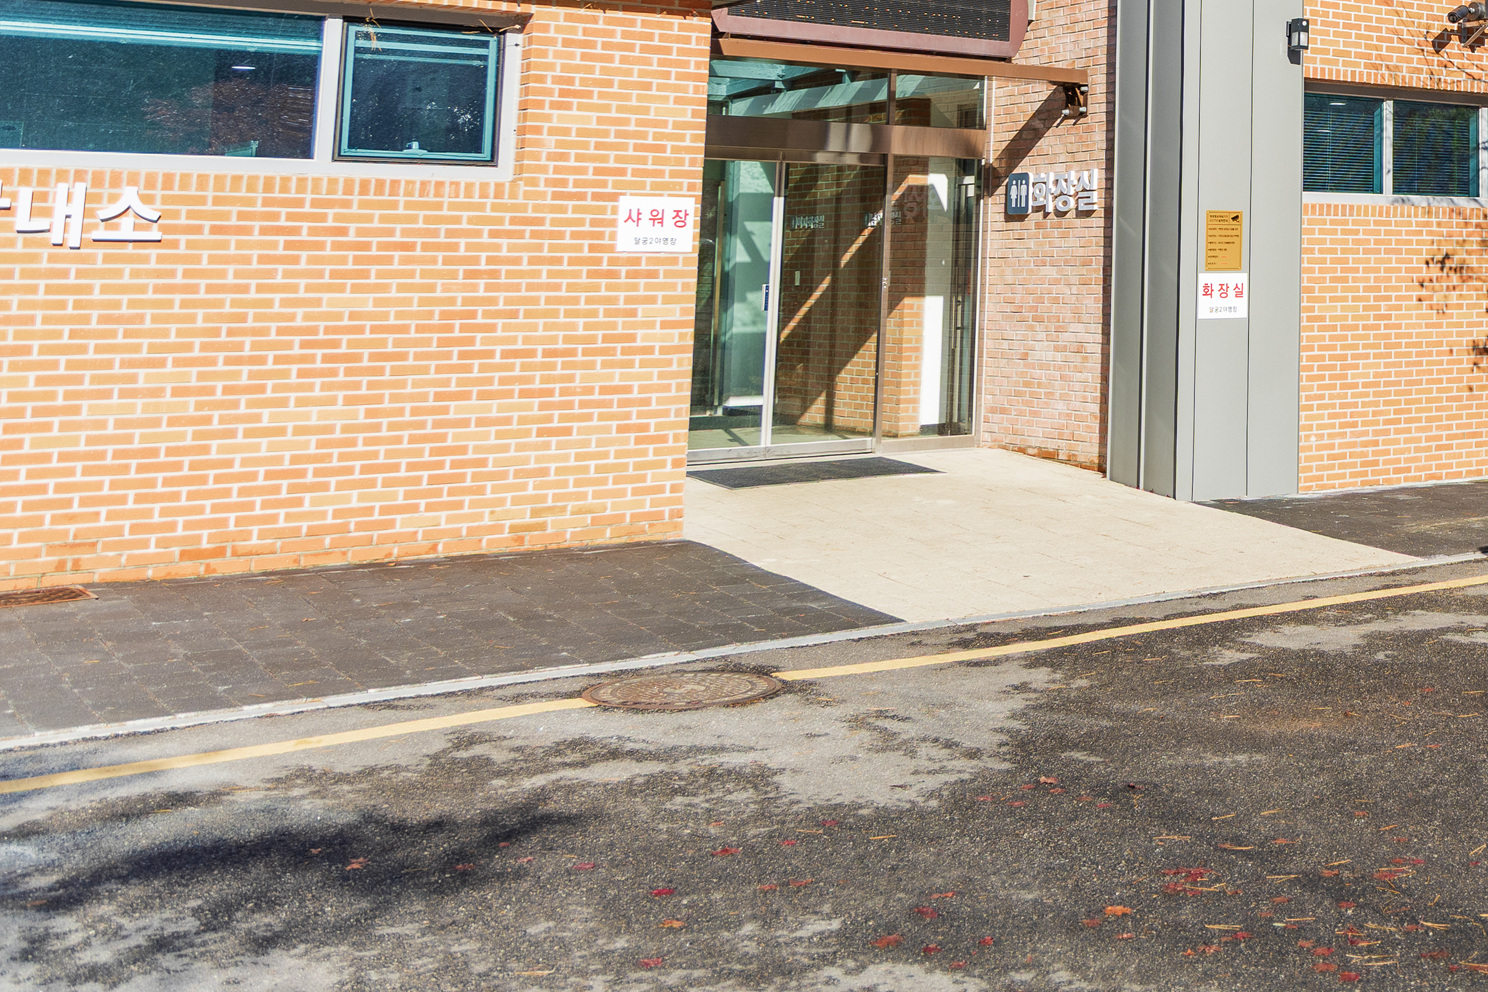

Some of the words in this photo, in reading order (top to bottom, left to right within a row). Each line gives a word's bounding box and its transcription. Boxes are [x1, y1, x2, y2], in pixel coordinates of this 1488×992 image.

[1032, 168, 1098, 213] 화장실
[0, 180, 163, 250] 내소
[623, 208, 690, 228] 샤워장
[1202, 283, 1244, 299] 화장실
